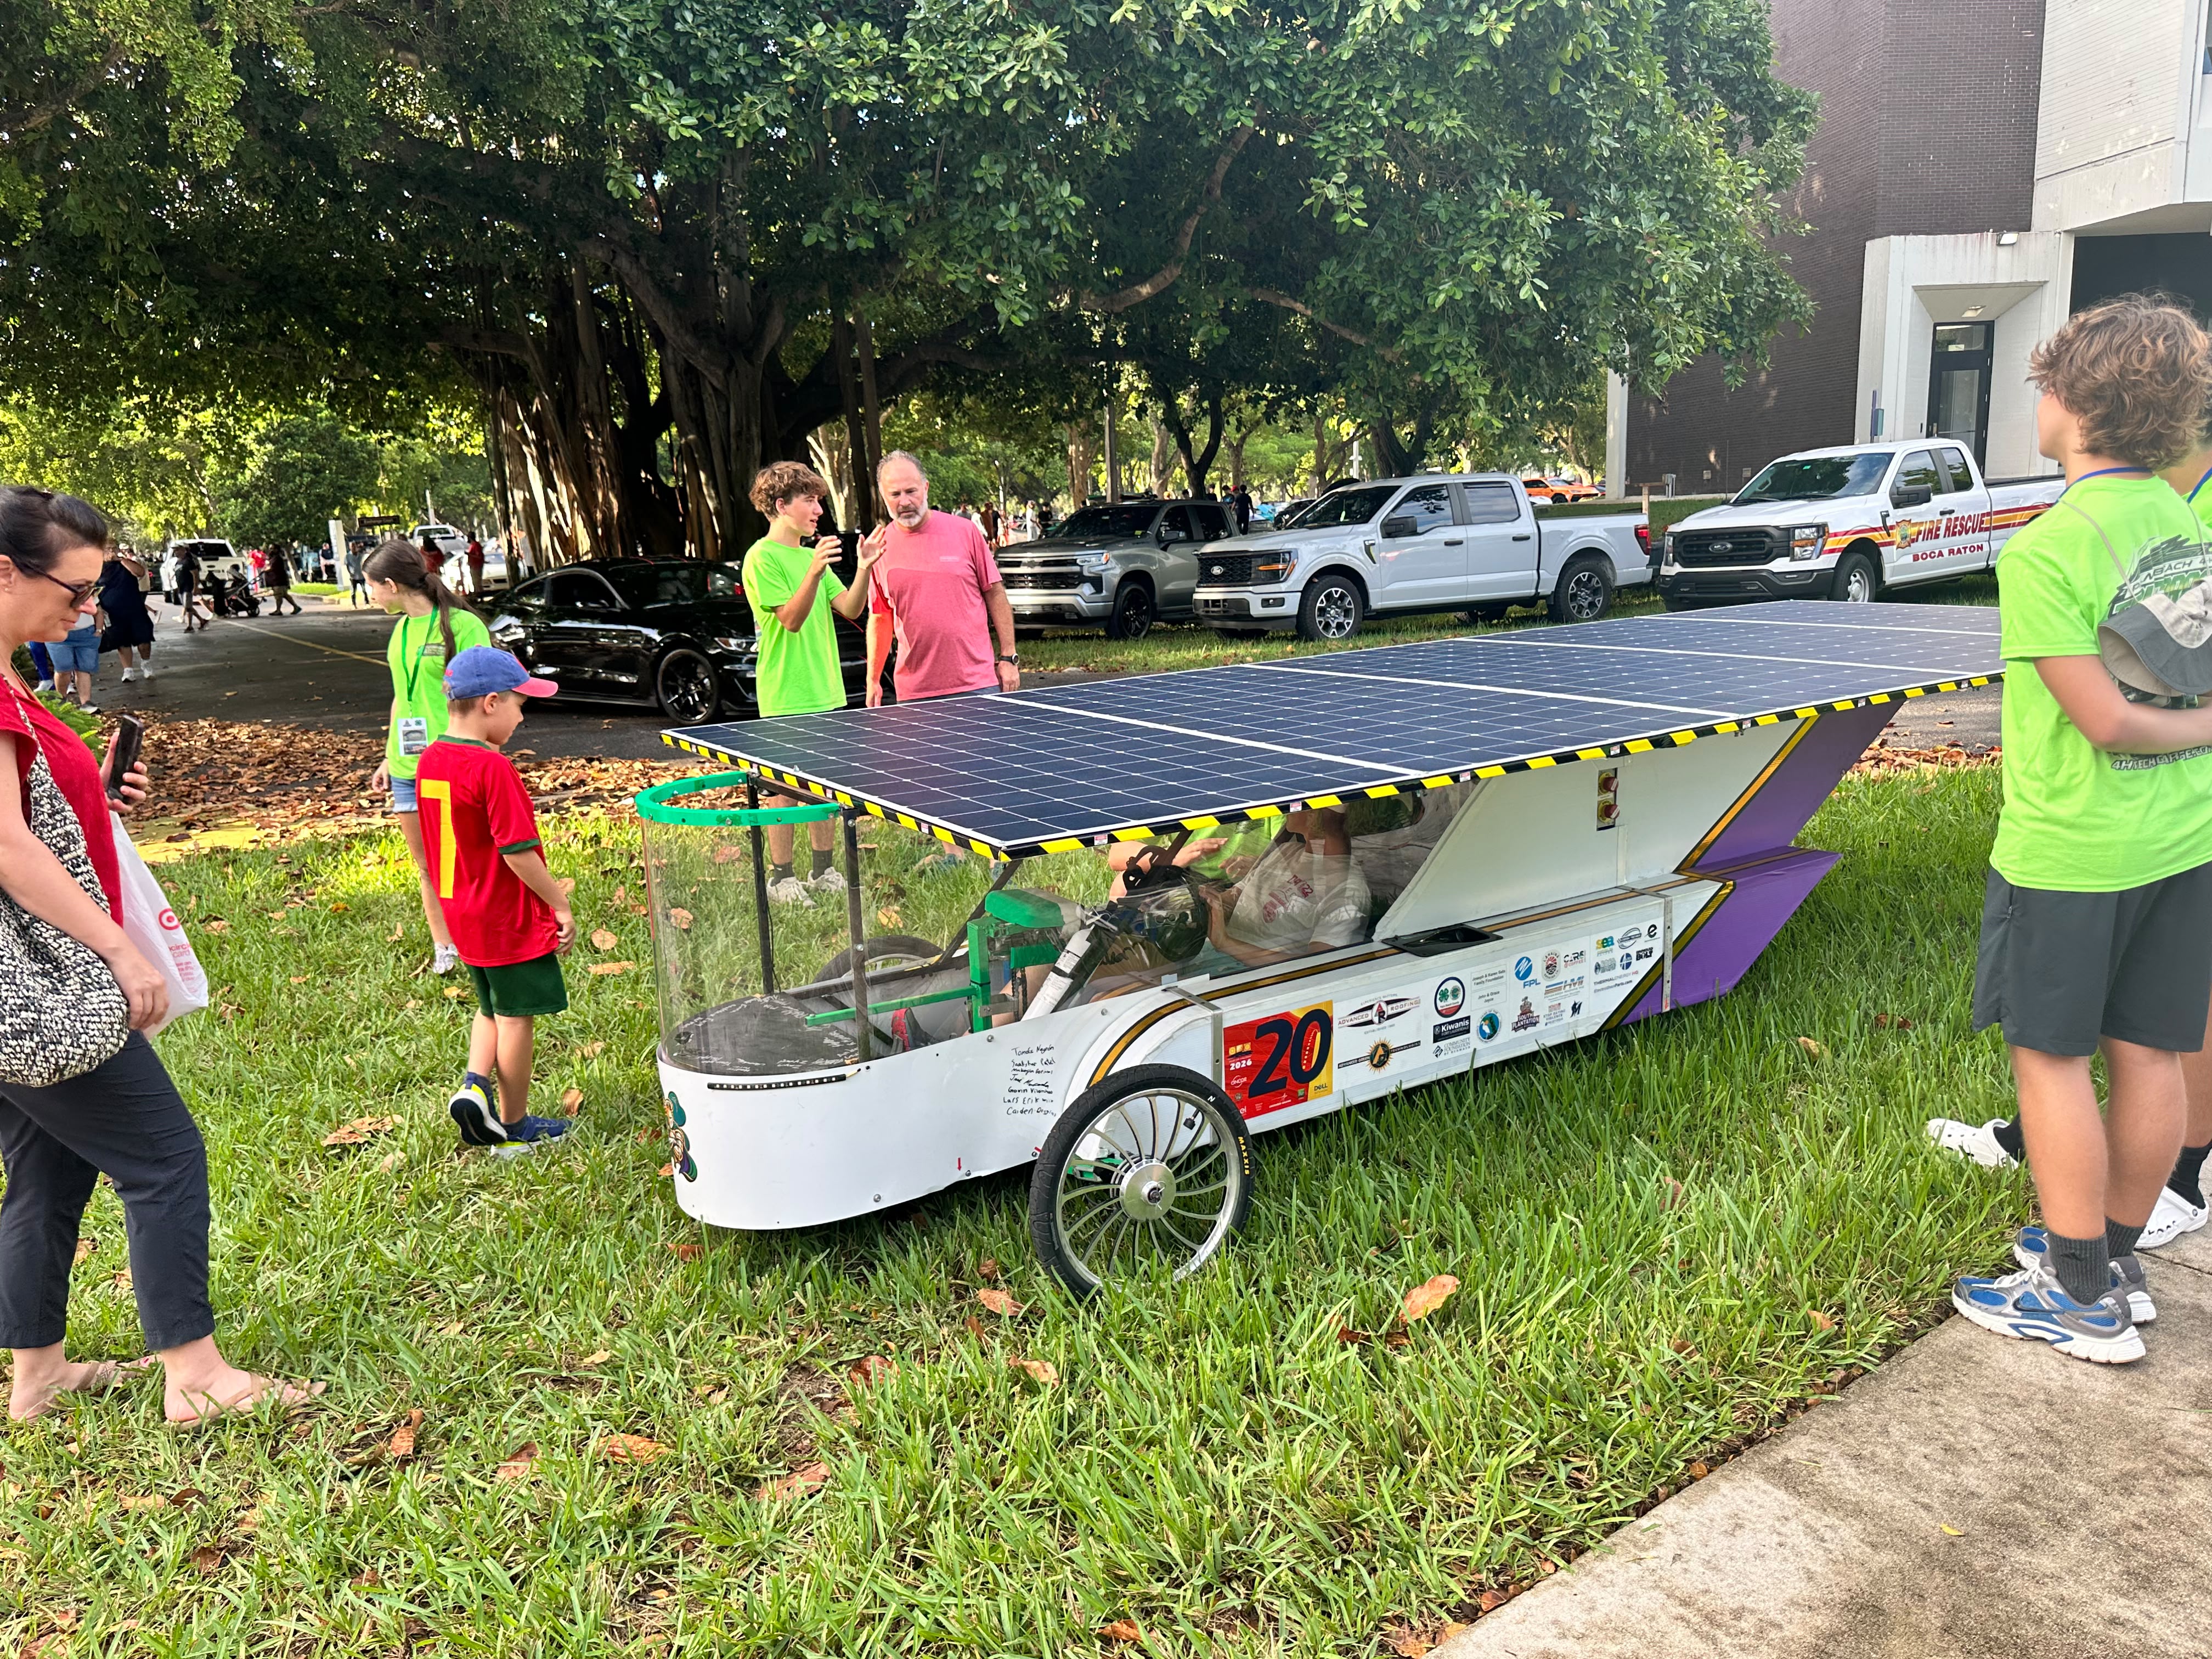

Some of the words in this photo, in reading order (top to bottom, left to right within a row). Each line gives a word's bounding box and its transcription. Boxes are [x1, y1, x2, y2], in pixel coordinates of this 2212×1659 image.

[1915, 518, 1943, 543] FIRE
[1943, 512, 1986, 538] RESCUE
[1912, 550, 1944, 562] BOCA
[1948, 544, 1983, 556] RATON
[421, 778, 457, 899] 7
[1523, 978, 1541, 988] FPL
[1338, 1013, 1369, 1025] ADVANCED
[1391, 1000, 1419, 1011] ROOFING
[1441, 1019, 1469, 1032] Kiwanis
[1513, 1017, 1539, 1028] PLANTATION
[1248, 1009, 1331, 1099] 20
[1229, 1059, 1252, 1070] 2026
[1314, 1083, 1328, 1091] DELL
[1238, 1137, 1250, 1175] MAXXIS
